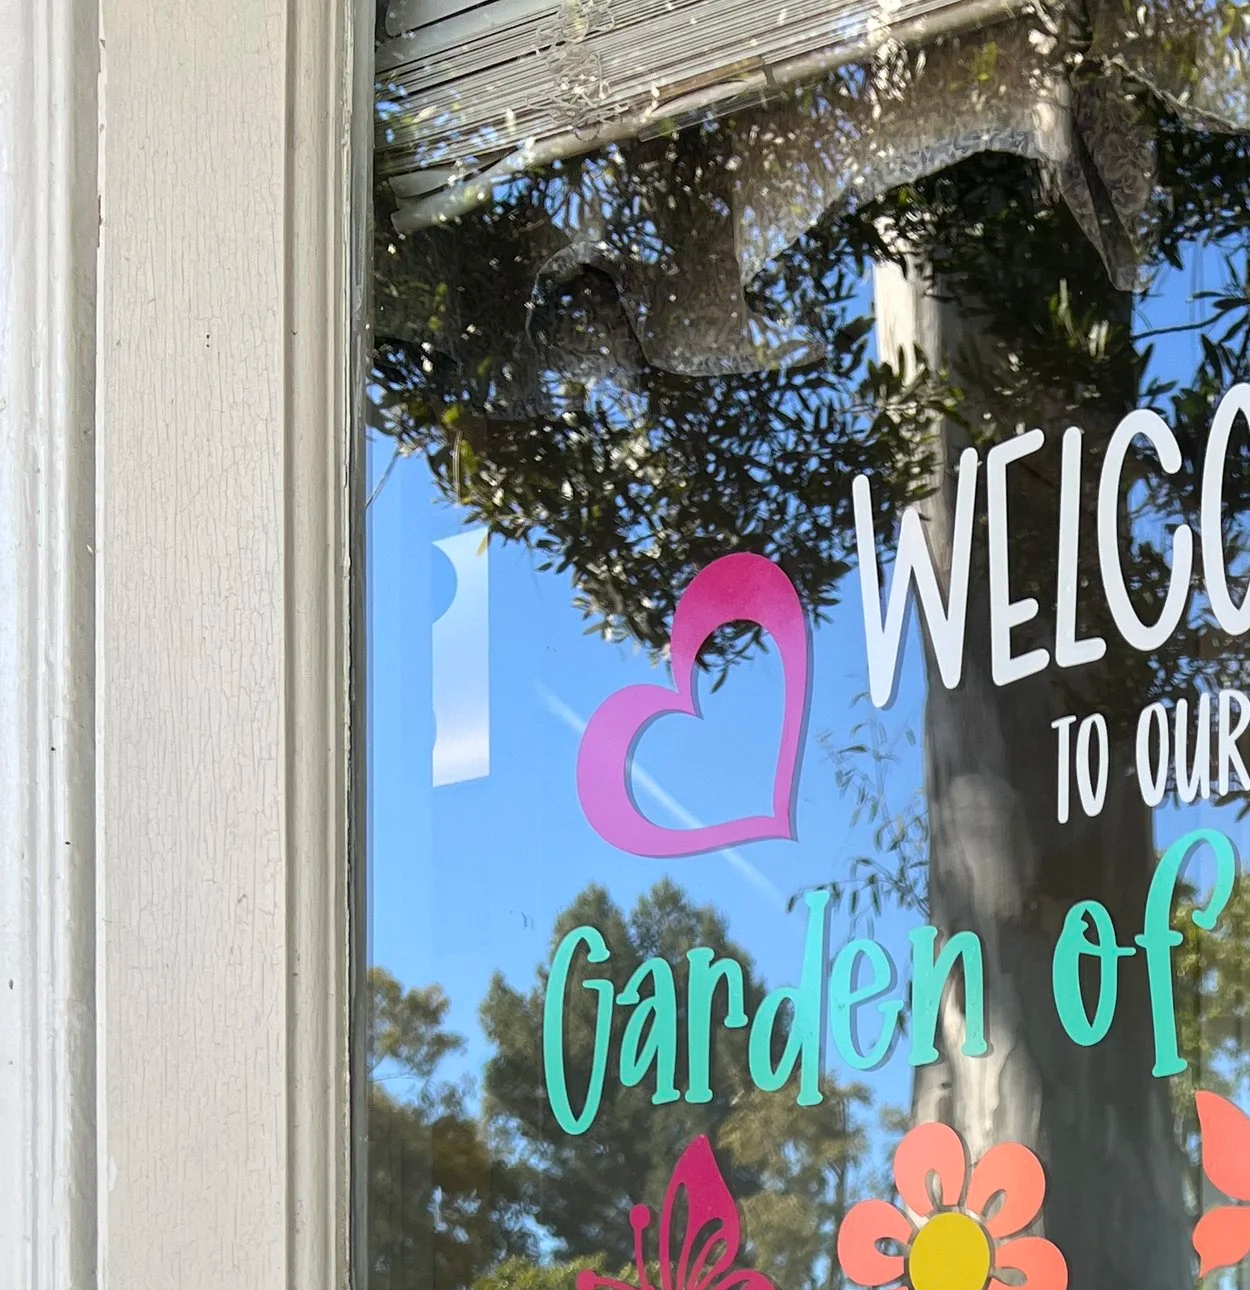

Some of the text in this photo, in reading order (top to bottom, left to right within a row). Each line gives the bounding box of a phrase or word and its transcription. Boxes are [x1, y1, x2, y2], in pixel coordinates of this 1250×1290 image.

[1051, 713, 1110, 823] TO
[543, 890, 989, 1135] Garden
[1052, 829, 1236, 1077] of
